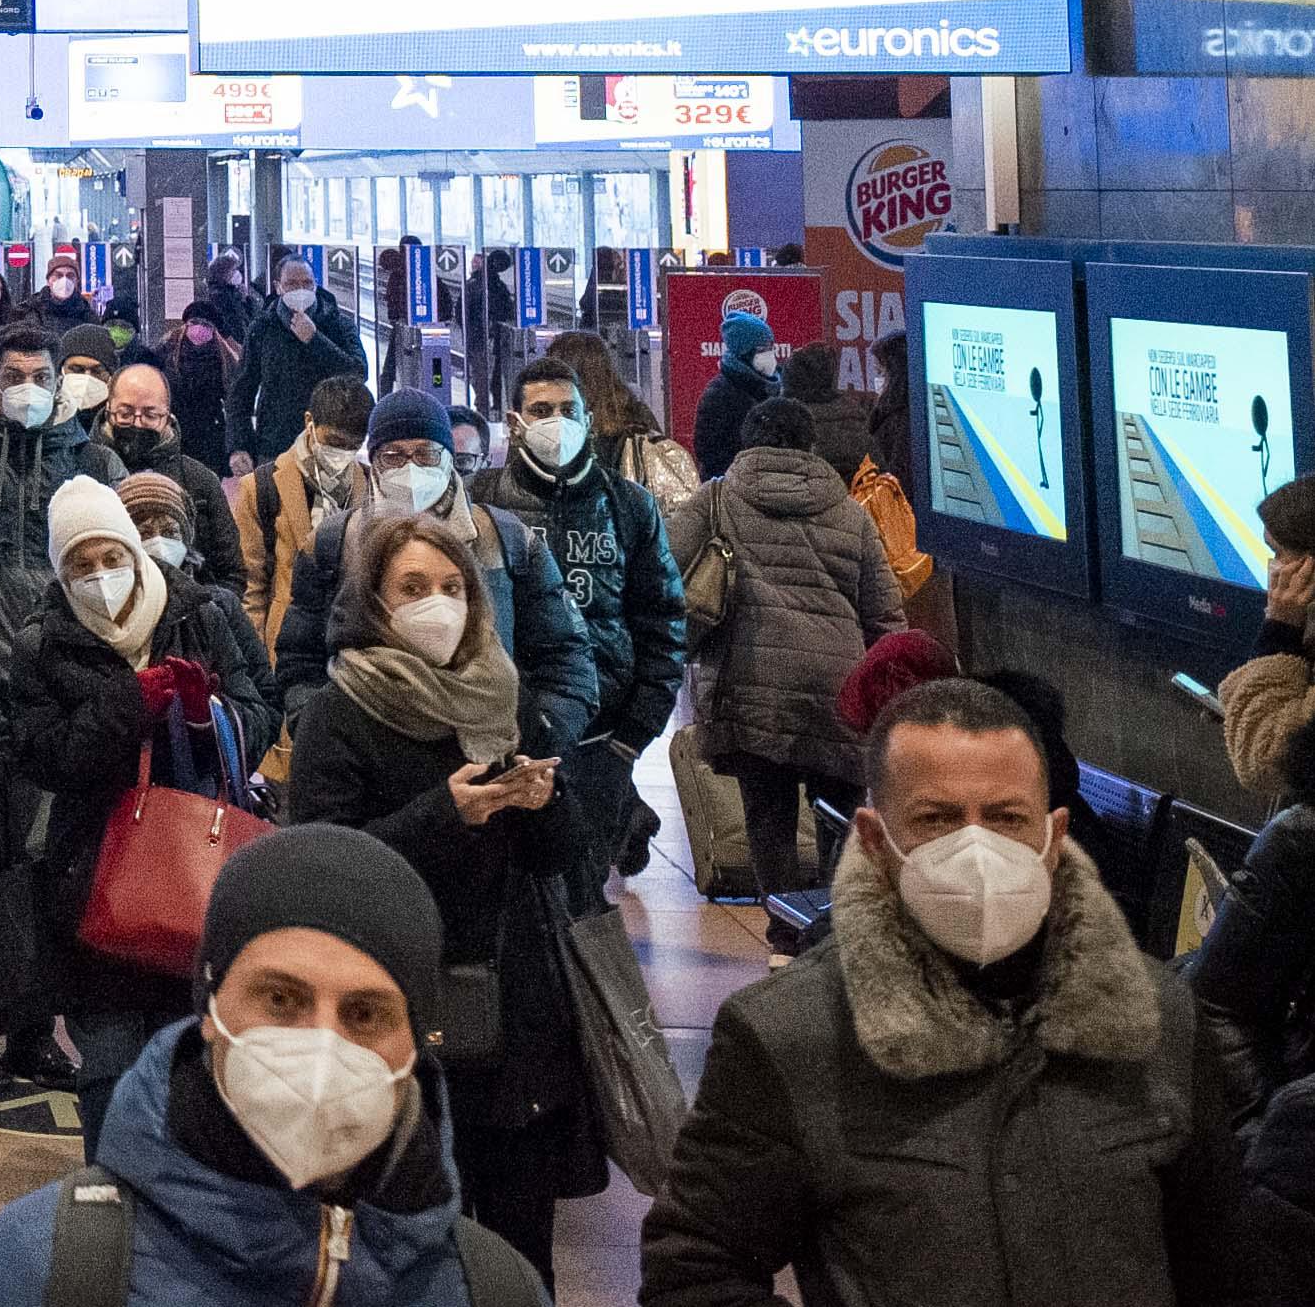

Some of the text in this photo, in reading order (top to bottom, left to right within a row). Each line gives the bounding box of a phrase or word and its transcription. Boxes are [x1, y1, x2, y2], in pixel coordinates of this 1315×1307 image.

[523, 38, 681, 59] www.euronics.it
[813, 19, 1001, 59] euronics
[213, 82, 272, 98] 499€
[675, 104, 751, 124] 329€
[242, 133, 299, 146] euronics
[711, 134, 770, 148] euronics
[856, 159, 947, 208] BURGER
[861, 183, 953, 243] KING
[835, 290, 906, 342] SIA
[701, 341, 727, 357] SIA
[952, 343, 1005, 375] CON LE GAMBE
[1149, 366, 1218, 404] CON LE GAMBE
[567, 568, 593, 608] 3
